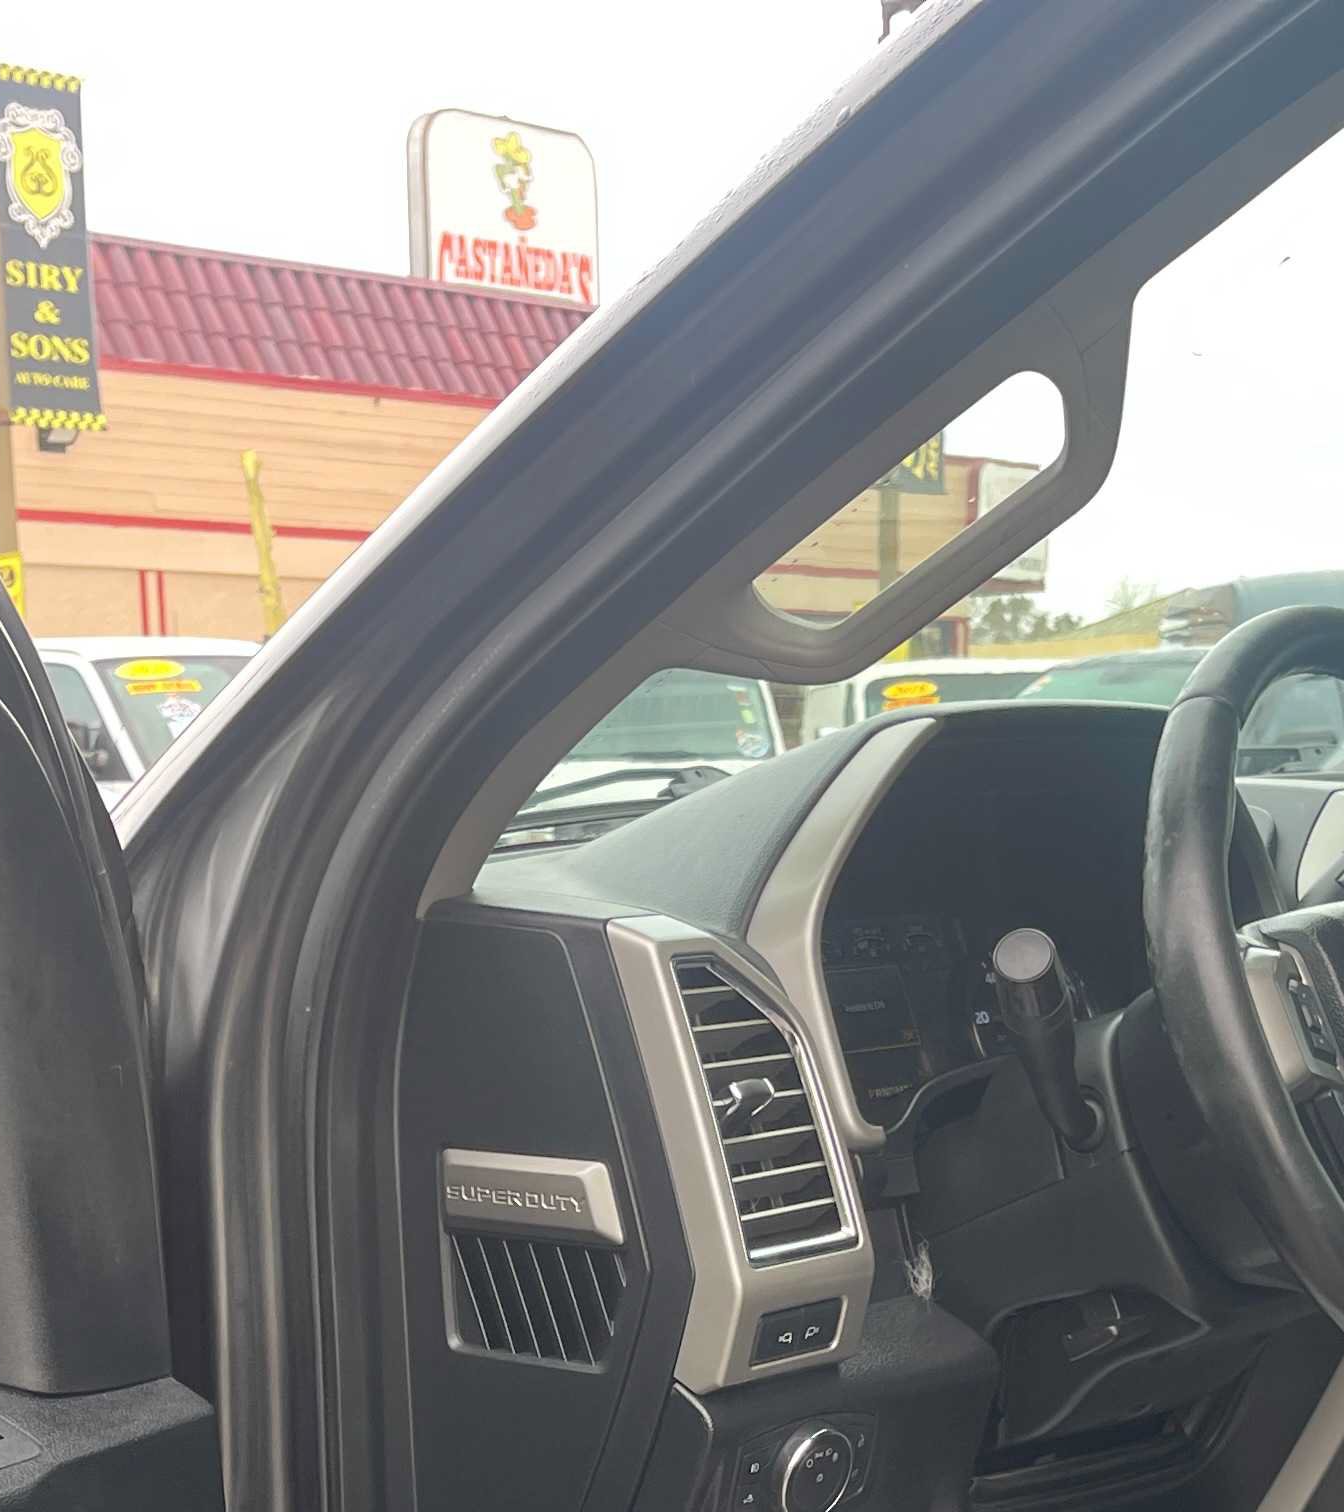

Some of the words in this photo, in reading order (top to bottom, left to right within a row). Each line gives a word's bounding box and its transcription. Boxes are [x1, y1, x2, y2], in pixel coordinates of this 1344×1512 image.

[5, 258, 84, 294] SIRY
[33, 300, 62, 325] &
[9, 330, 91, 365] SONS
[446, 1184, 523, 1207] SUPER
[525, 1191, 582, 1213] DUTY
